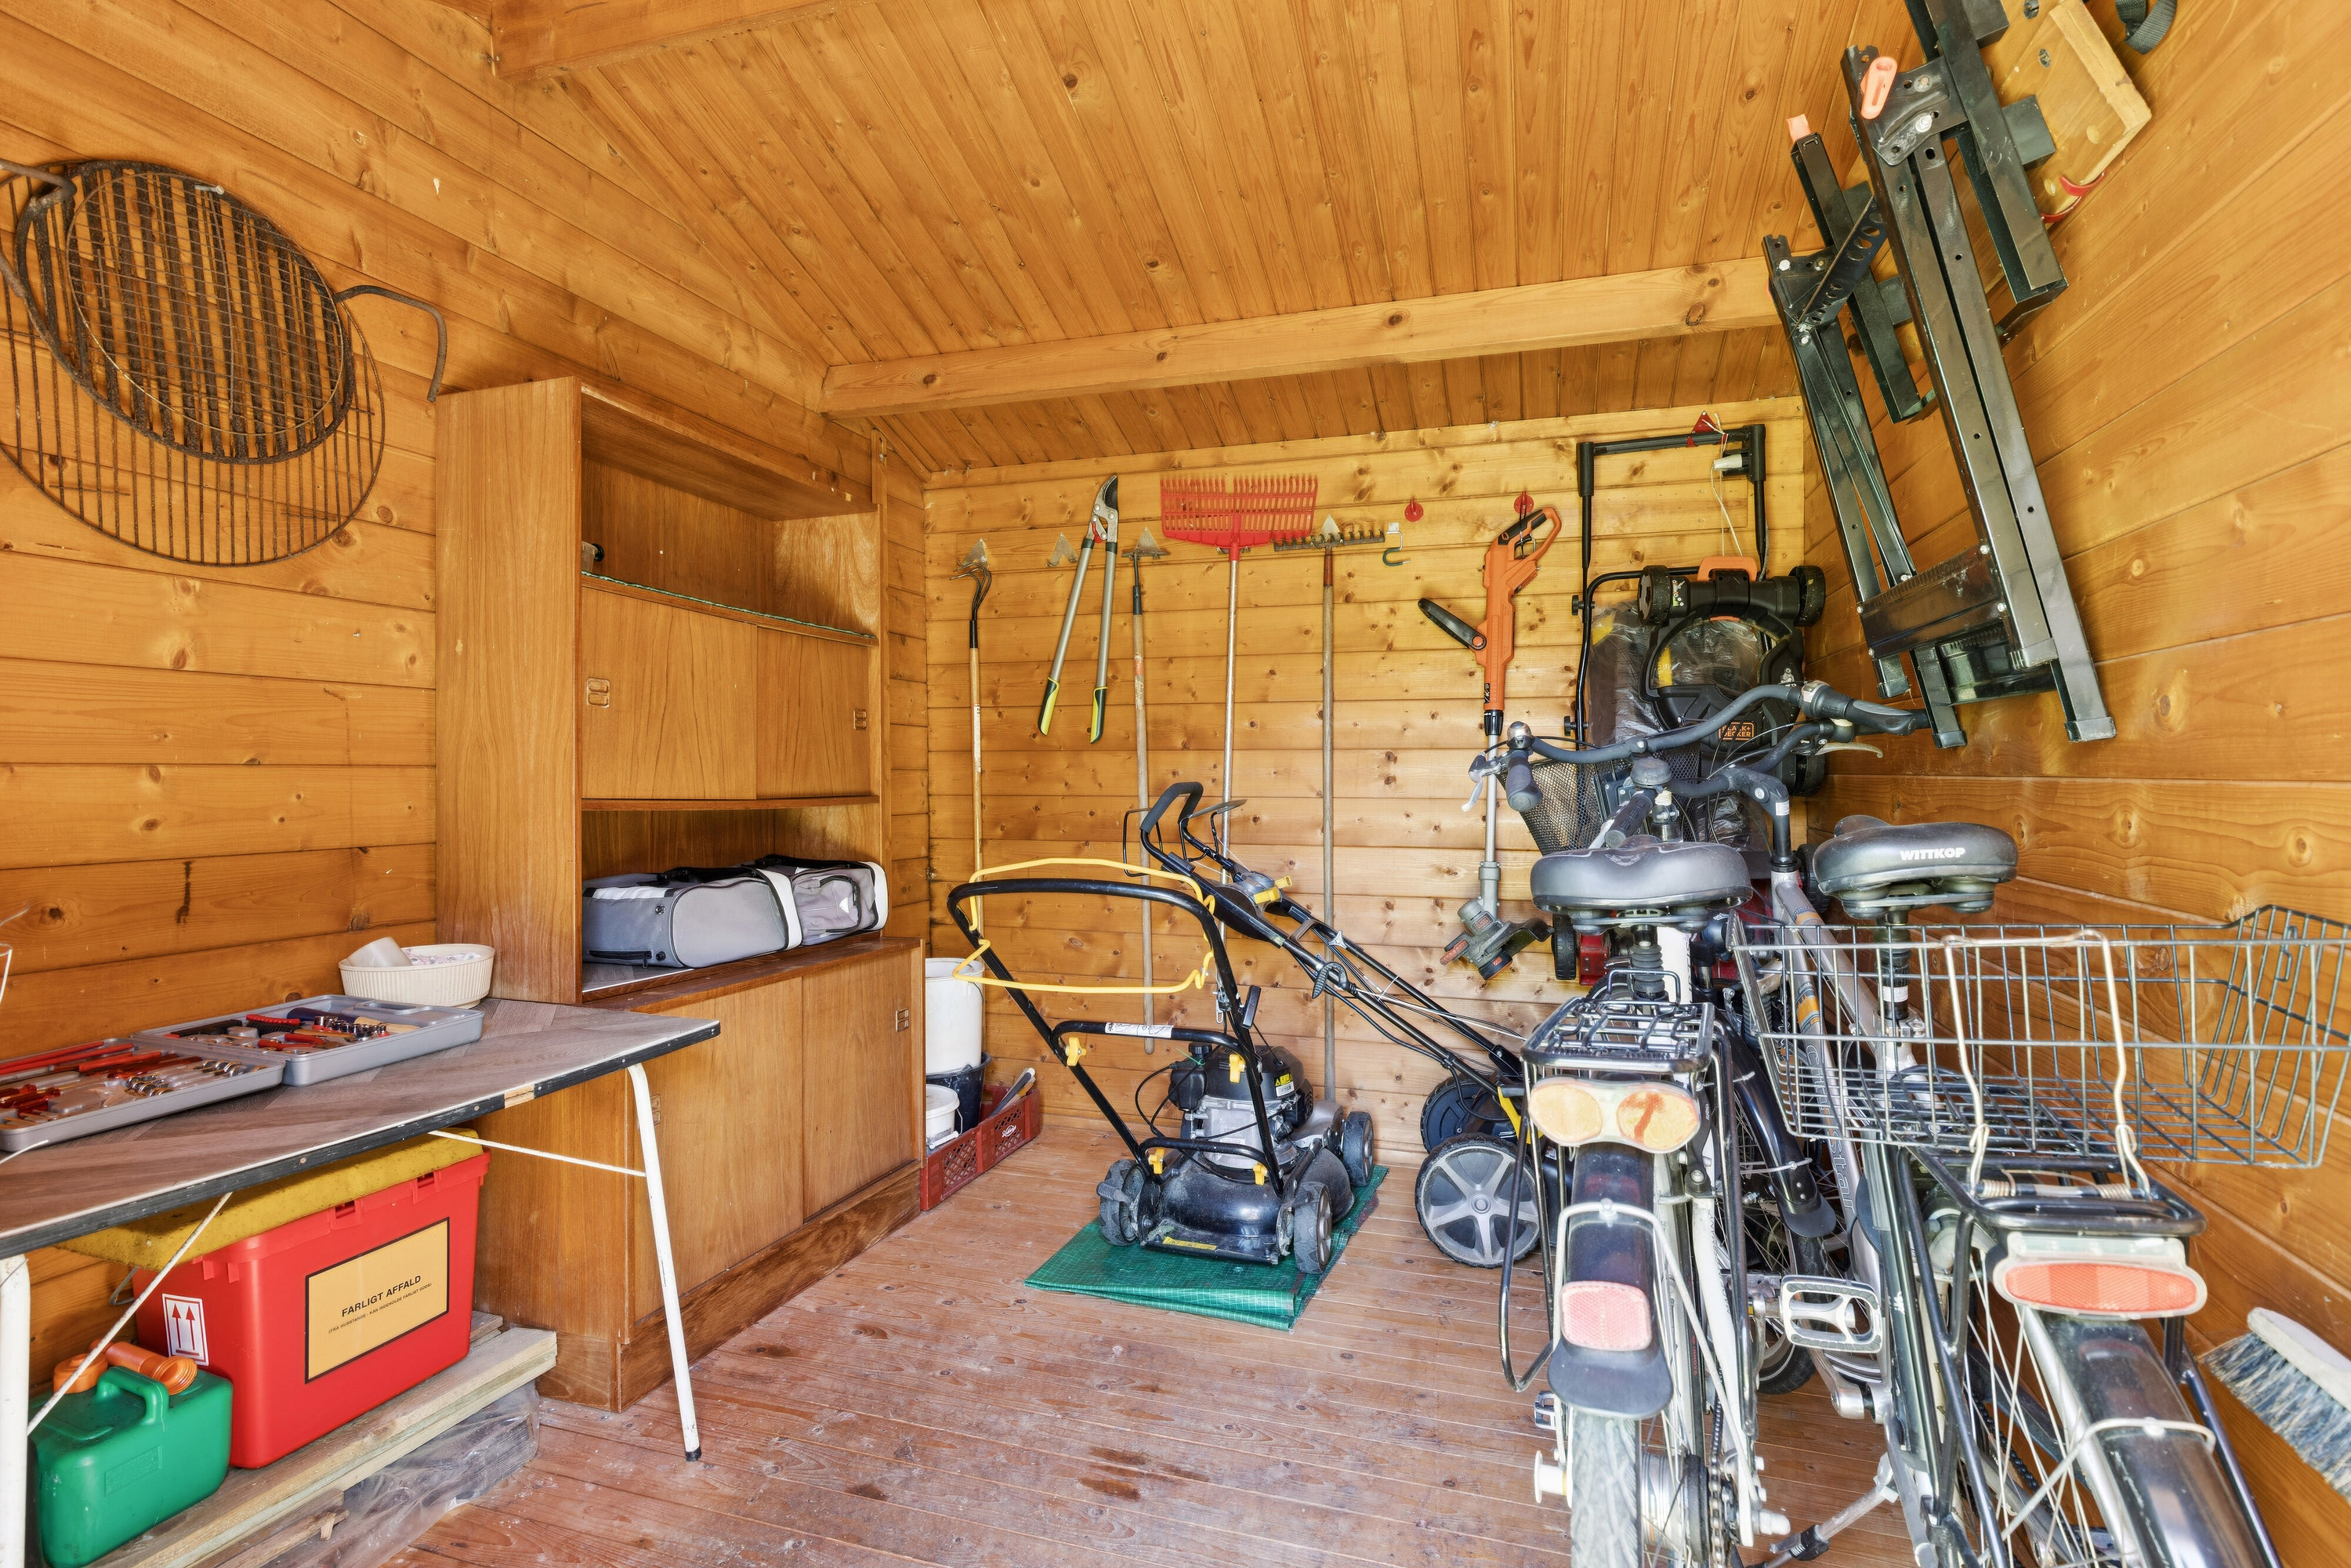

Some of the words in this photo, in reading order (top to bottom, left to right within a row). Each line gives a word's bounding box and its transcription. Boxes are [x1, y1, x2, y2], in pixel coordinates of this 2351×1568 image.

[1900, 847, 1965, 860] WITTKOP
[1827, 1130, 1857, 1215] Star
[328, 1325, 339, 1334] (FRA
[340, 1313, 366, 1328] HUSSTANDE
[379, 1297, 402, 1310] INDEHOLDE
[403, 1288, 418, 1299] FARLIGT
[419, 1283, 433, 1291] GODS)
[342, 1292, 383, 1316] FARLIGT
[386, 1275, 421, 1298] AFFALD
